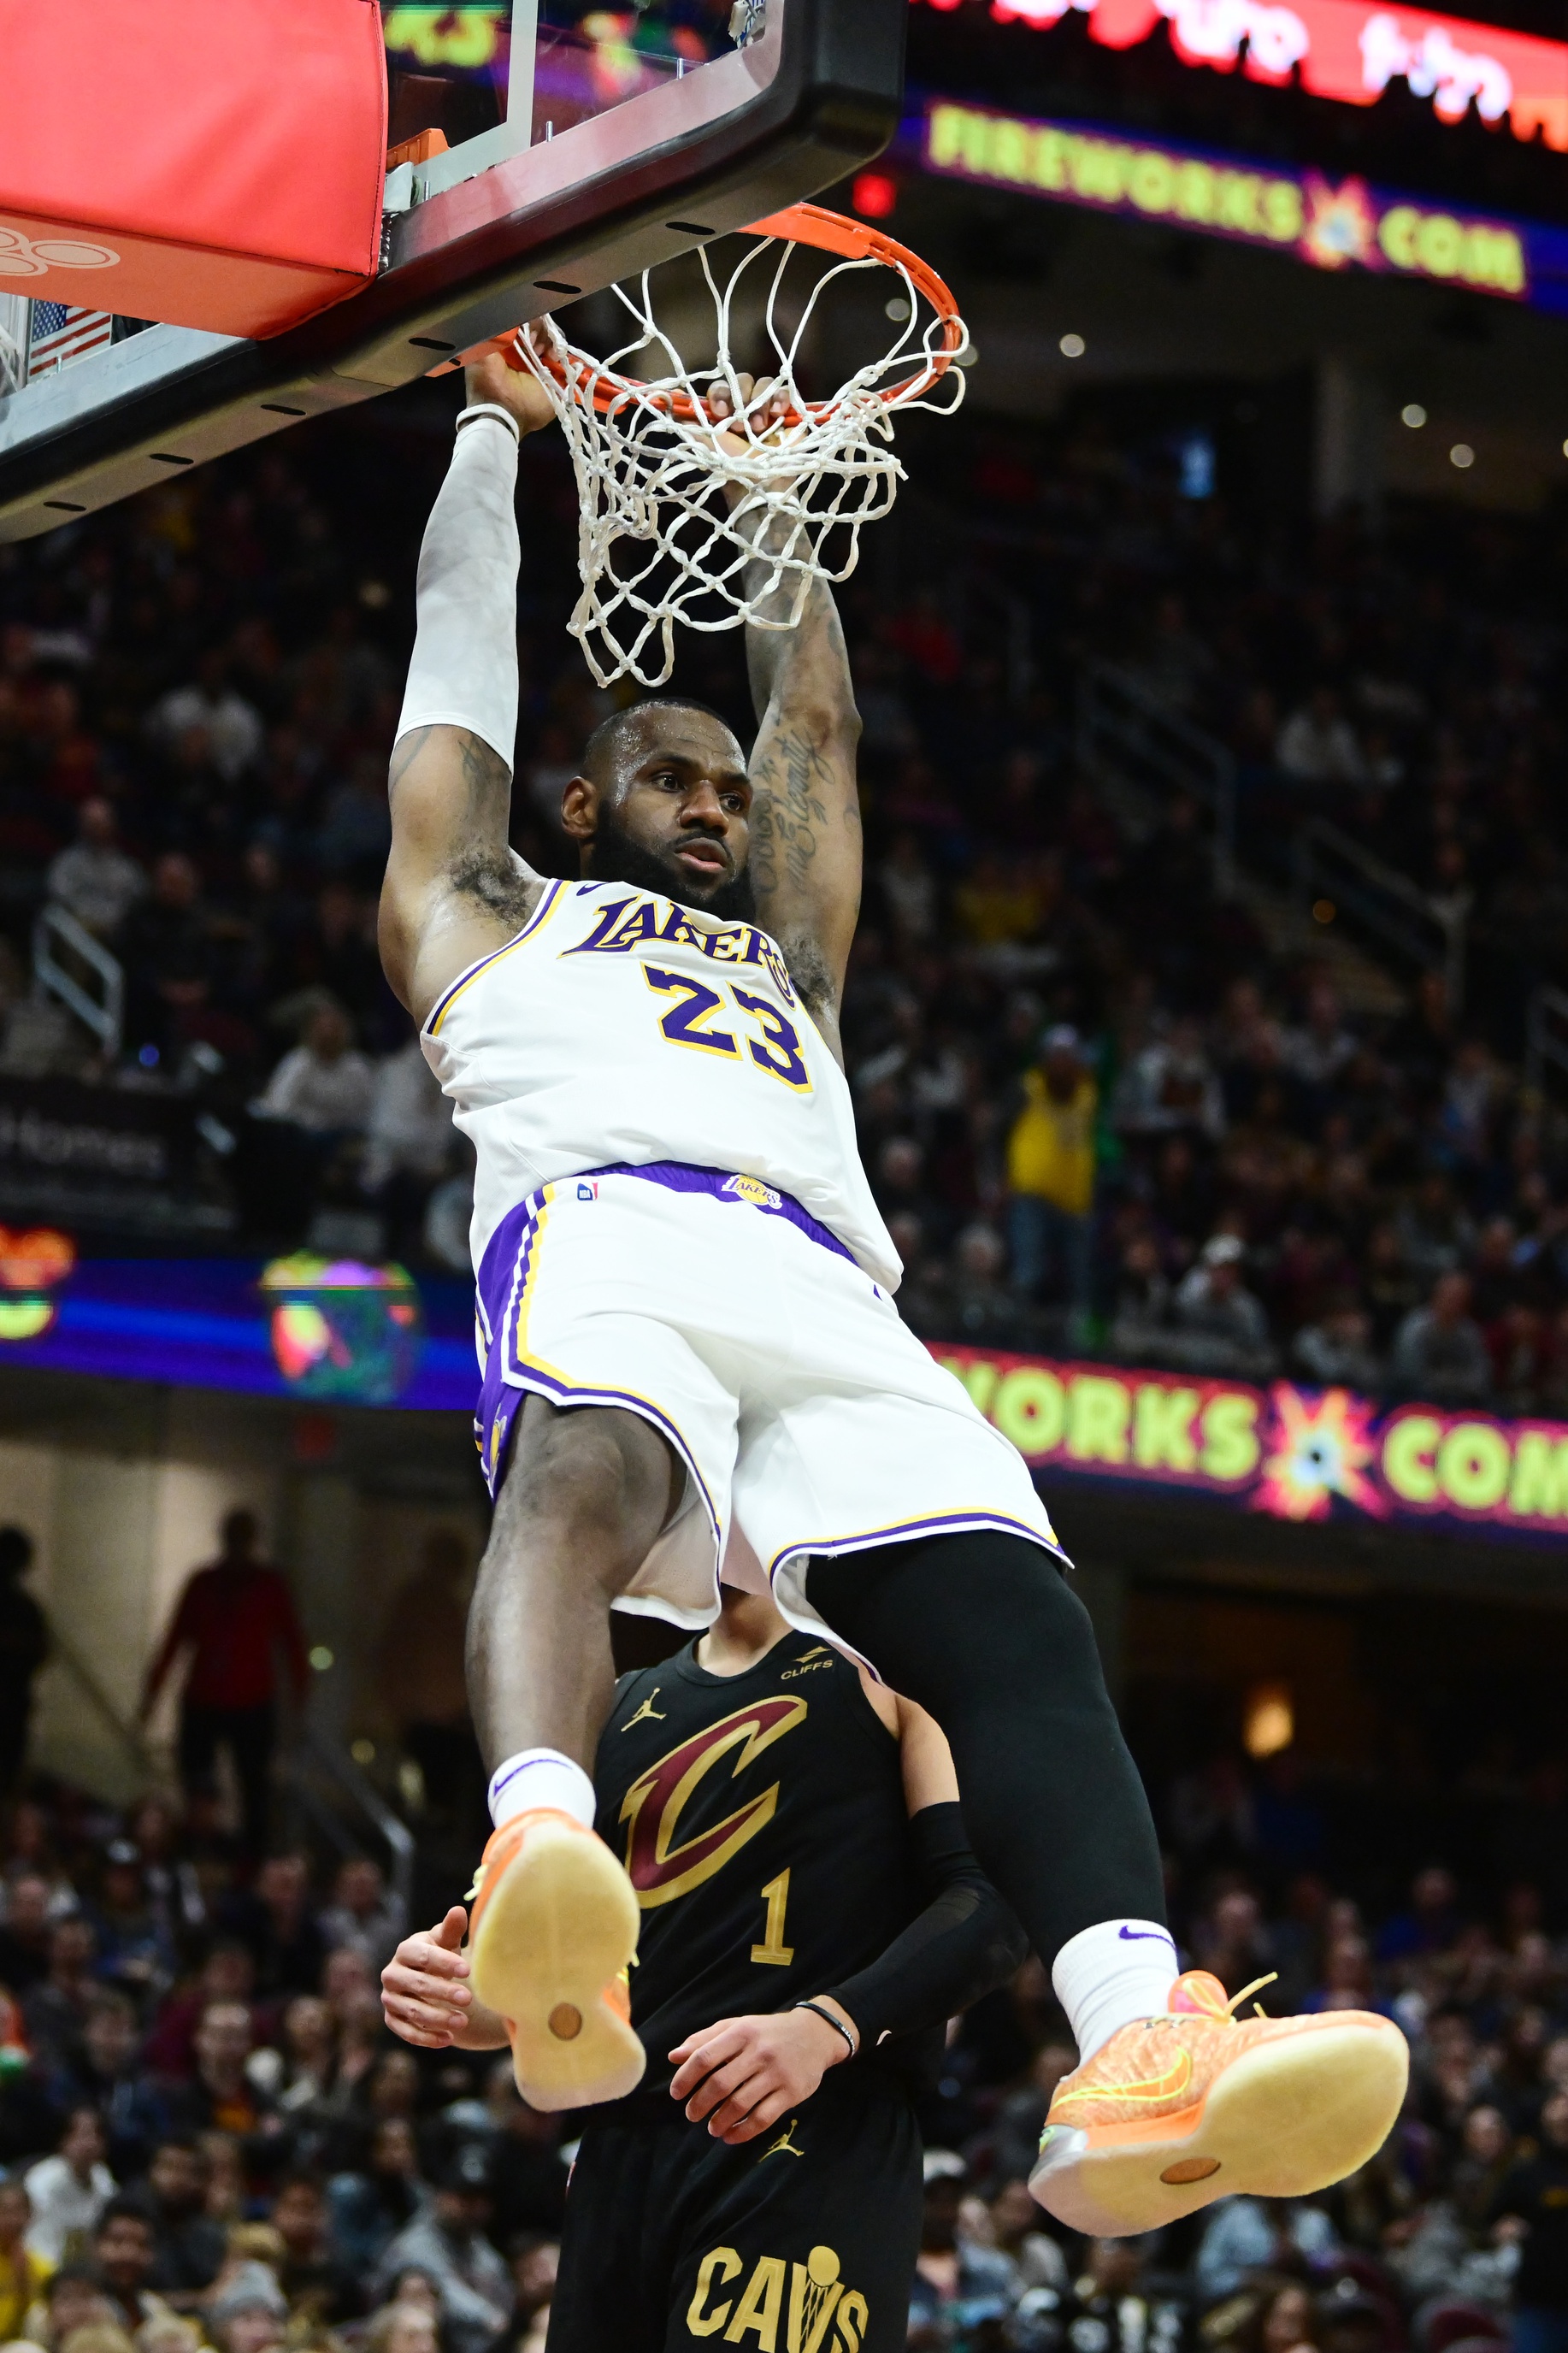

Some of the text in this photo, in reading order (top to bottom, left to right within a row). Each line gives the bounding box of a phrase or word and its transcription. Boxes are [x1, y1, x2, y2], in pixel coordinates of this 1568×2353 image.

[929, 104, 1524, 295] FIREWORKS COM
[557, 894, 796, 1011] LAKERS
[640, 960, 813, 1094] 23
[781, 1660, 834, 1680] CLIFFS
[751, 1867, 794, 1966] 1
[686, 2245, 869, 2353] CAVS
